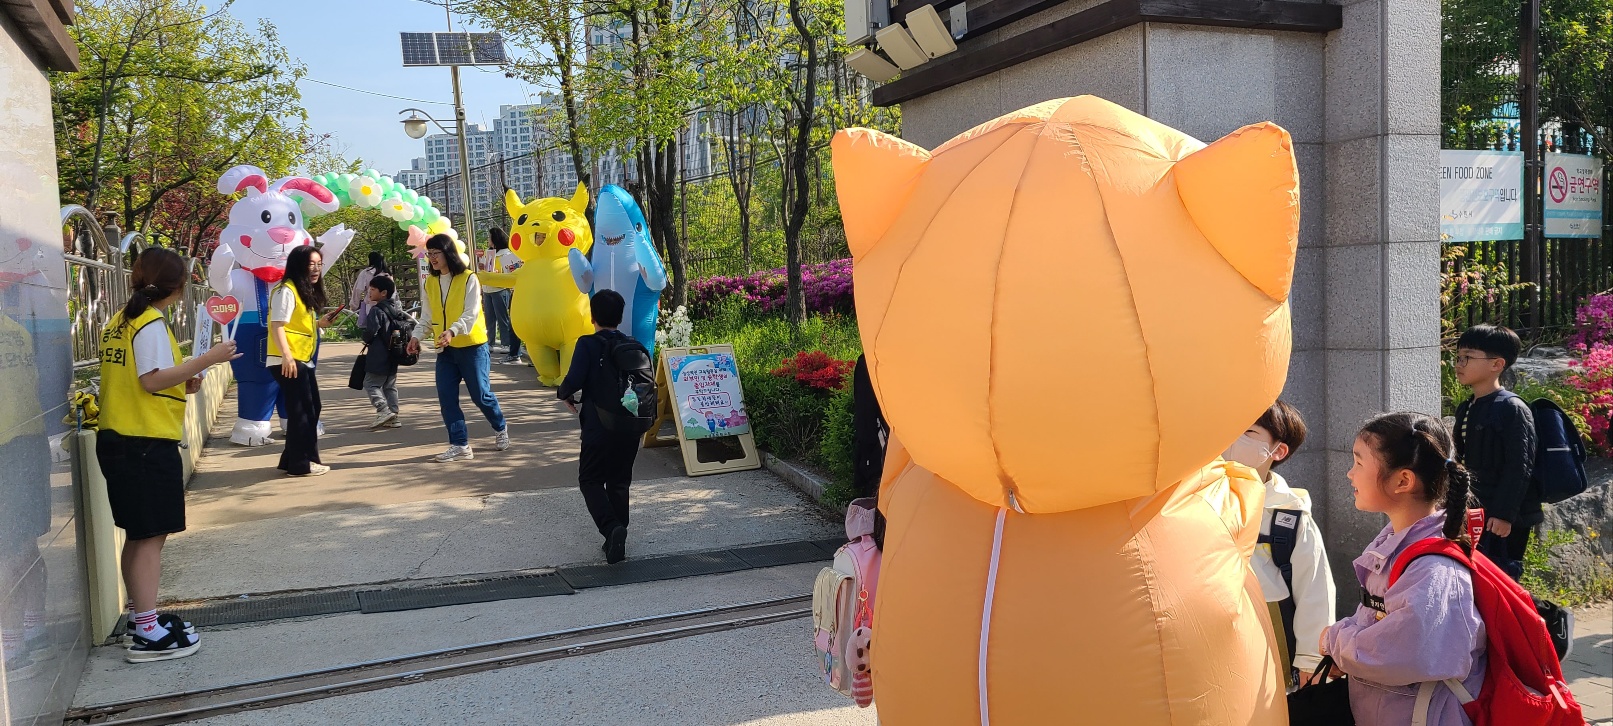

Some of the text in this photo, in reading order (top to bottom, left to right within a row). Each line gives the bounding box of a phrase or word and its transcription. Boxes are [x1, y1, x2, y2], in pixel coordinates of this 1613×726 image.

[1454, 166, 1474, 180] FOOD
[1475, 166, 1493, 180] ZONE
[1569, 176, 1599, 195] 금연구역
[210, 303, 237, 314] 고마워
